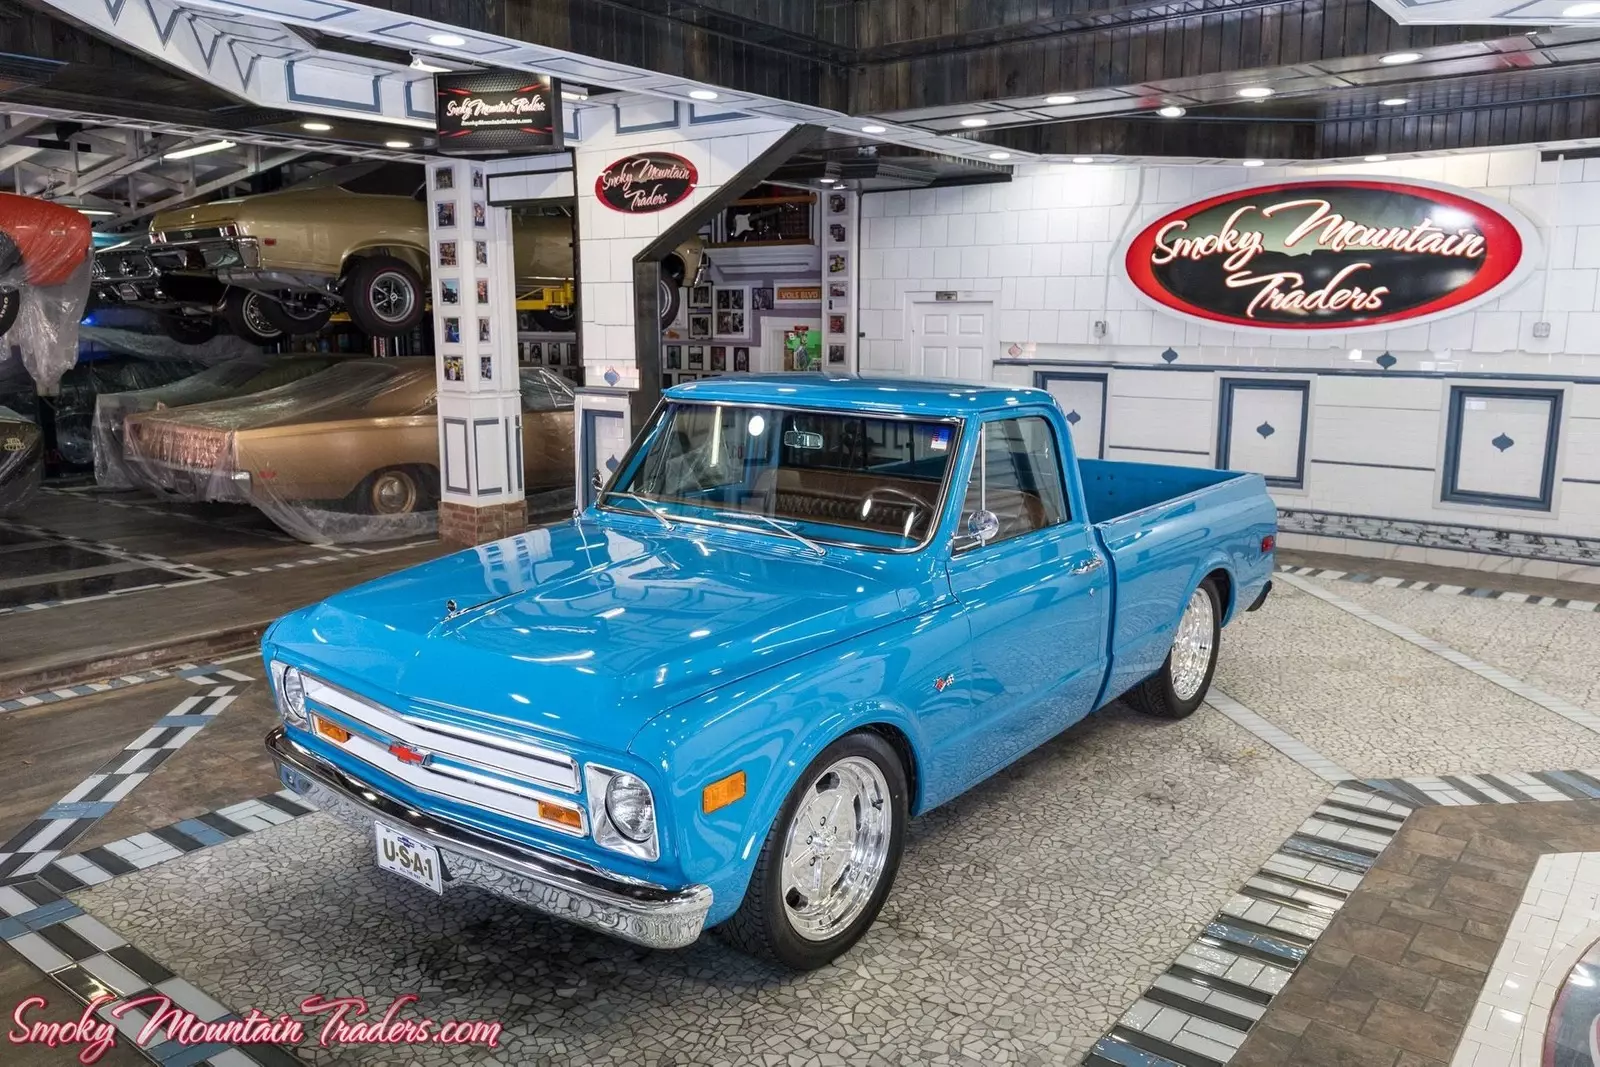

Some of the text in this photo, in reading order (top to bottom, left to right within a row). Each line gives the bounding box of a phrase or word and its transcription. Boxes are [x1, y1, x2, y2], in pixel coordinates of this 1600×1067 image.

[446, 94, 546, 120] Smoky Mountain Traders
[602, 158, 691, 191] Smoky Mountain
[623, 184, 668, 211] Traders
[1151, 199, 1486, 271] Smoky Mountain
[781, 291, 818, 299] VOLS BLVD
[1225, 263, 1391, 317] Traders
